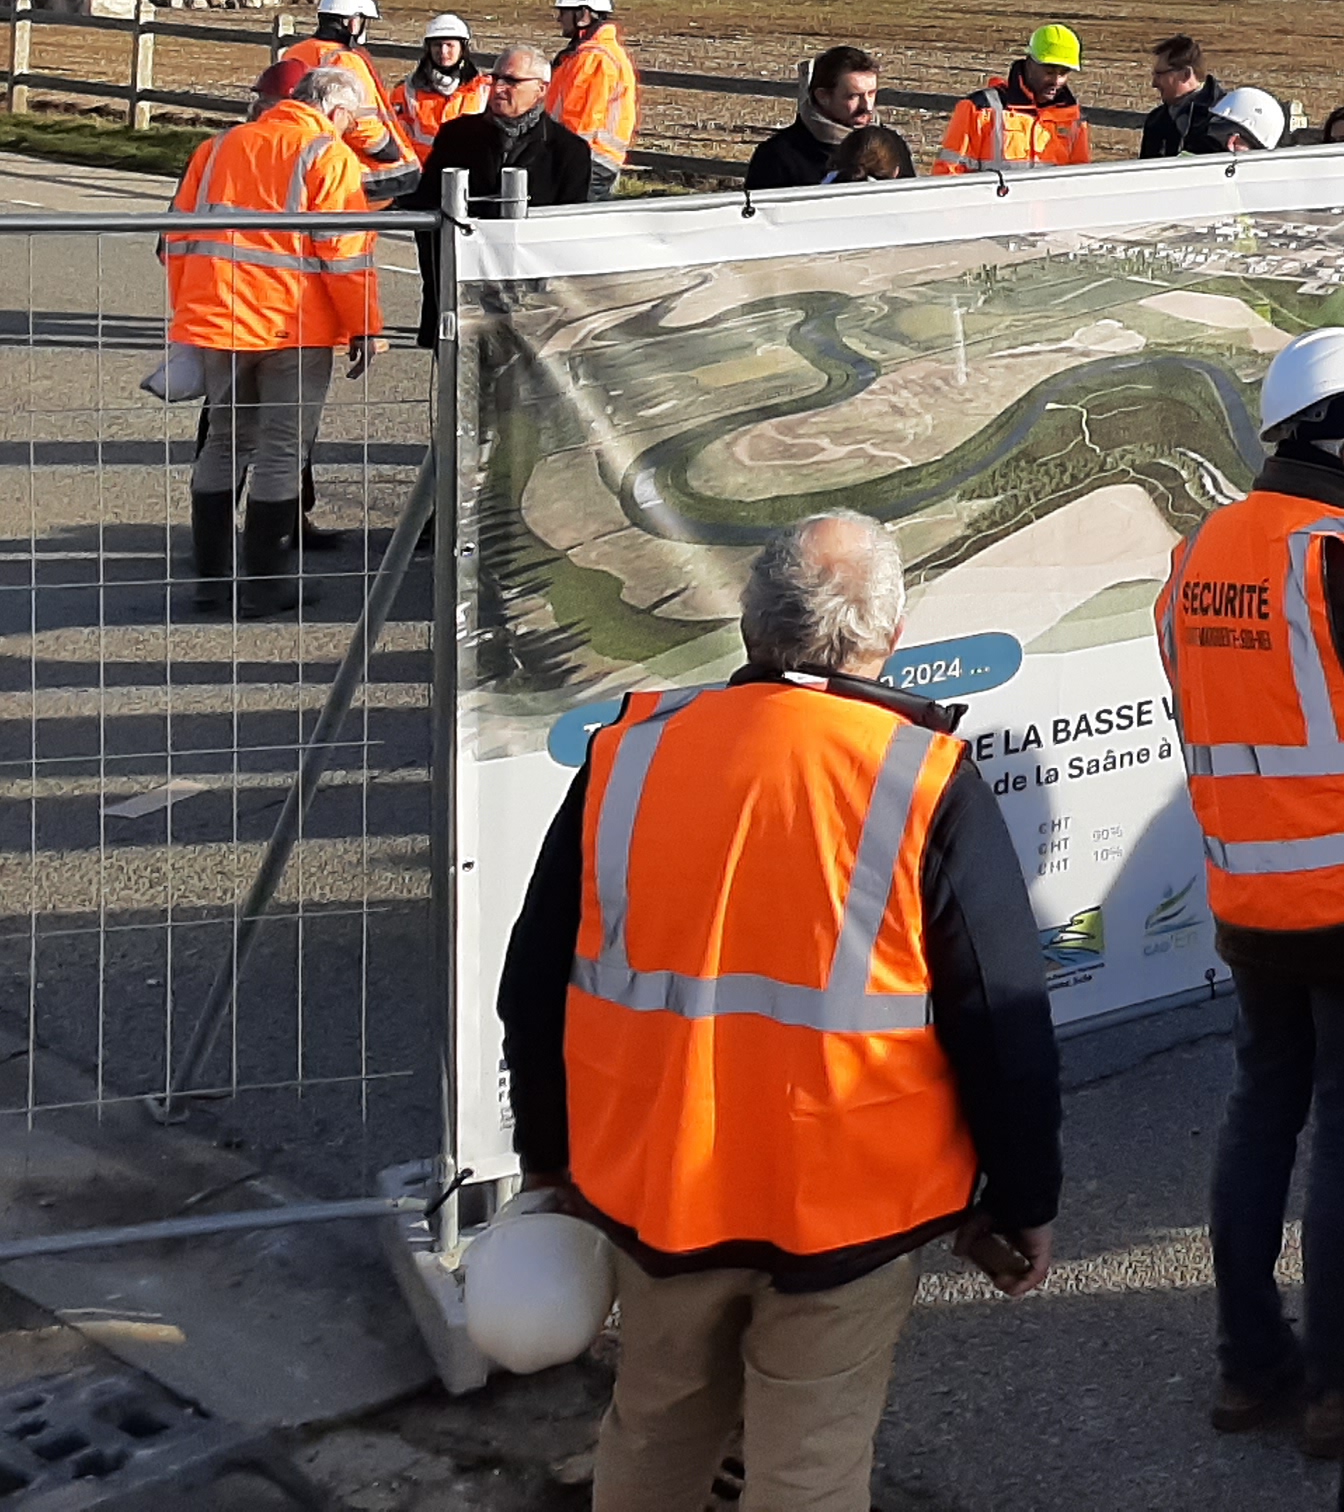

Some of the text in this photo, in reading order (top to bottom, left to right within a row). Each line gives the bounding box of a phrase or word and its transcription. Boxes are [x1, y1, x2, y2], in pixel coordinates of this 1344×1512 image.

[1182, 574, 1270, 620] SÉCURITÉ
[901, 657, 961, 688] 2024
[1003, 724, 1044, 755] LA
[1052, 699, 1153, 744] BASSE
[993, 736, 1172, 795] de la Saâne à
[1051, 816, 1071, 833] HT
[1050, 837, 1070, 854] HT
[1050, 857, 1069, 874] HT
